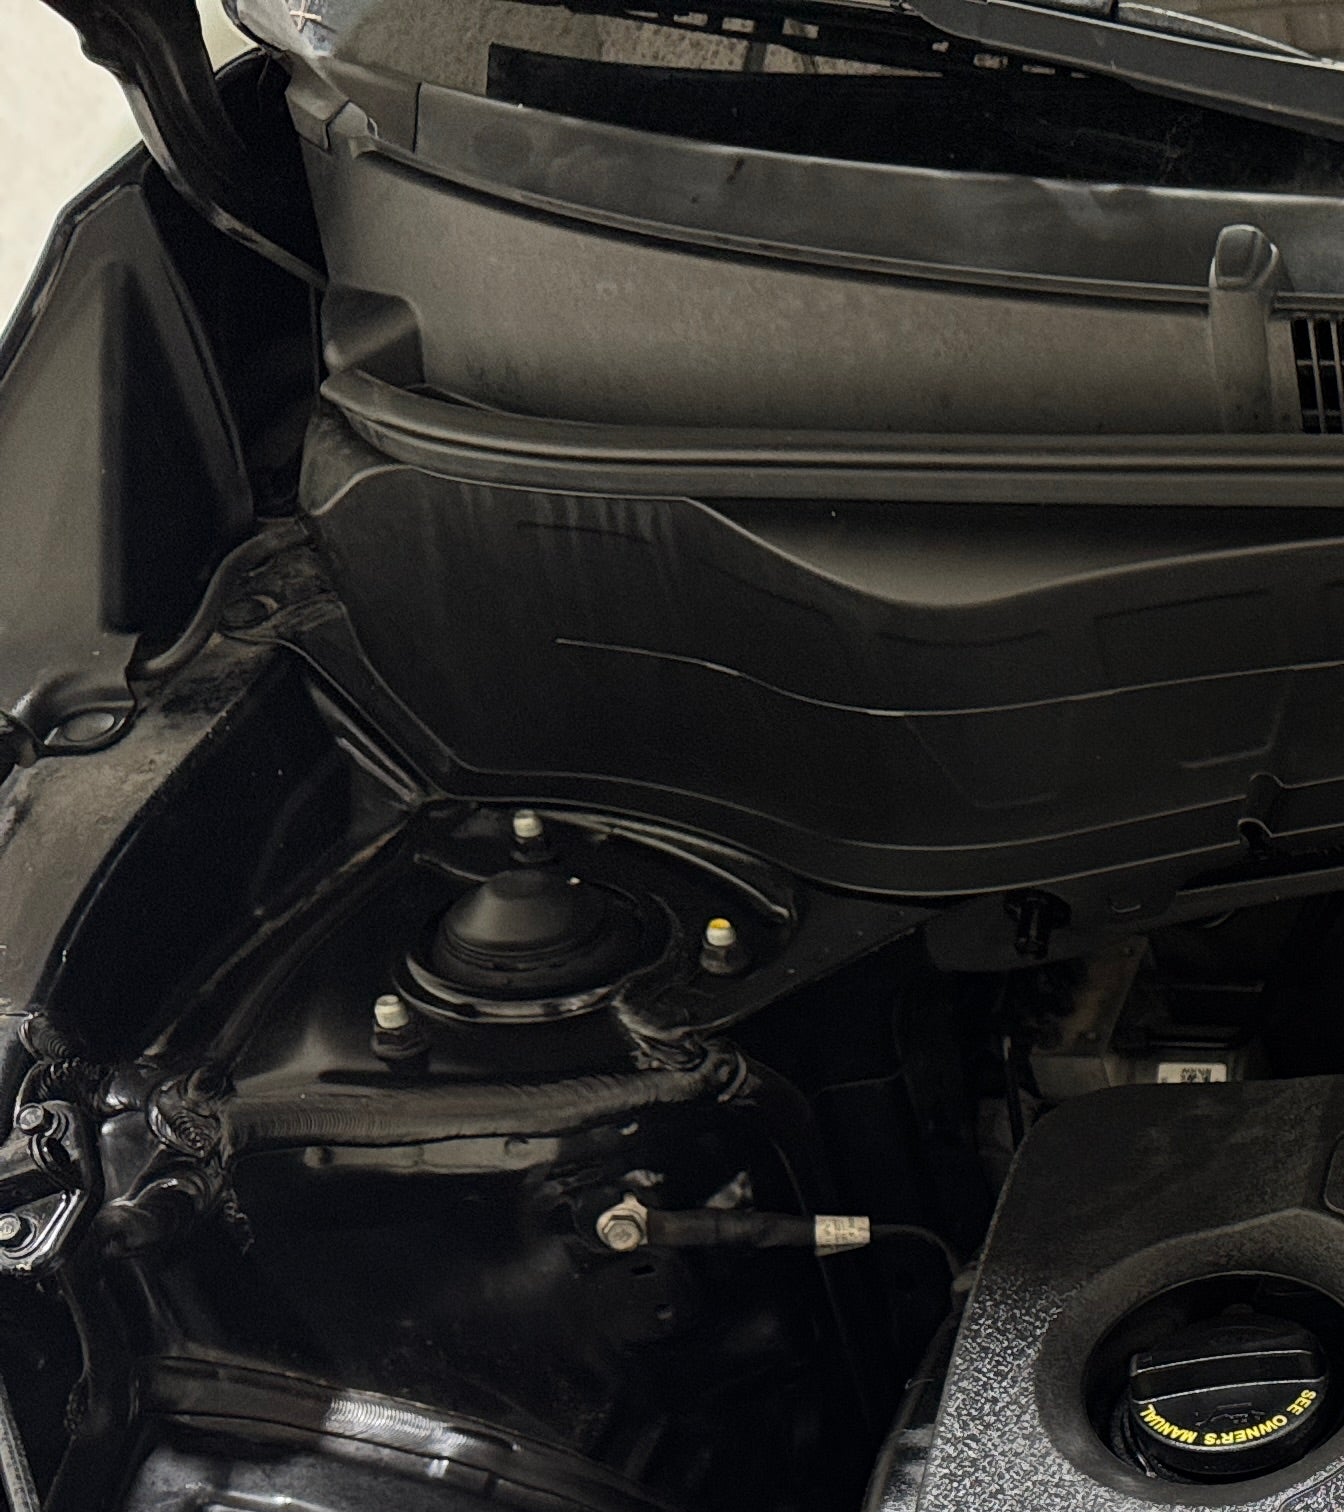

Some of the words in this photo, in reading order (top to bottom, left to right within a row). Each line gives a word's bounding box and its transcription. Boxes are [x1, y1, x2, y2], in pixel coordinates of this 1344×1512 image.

[1286, 1388, 1317, 1416] SEE
[1138, 1403, 1198, 1444] MANUAL
[1204, 1413, 1288, 1446] OWNER'S
